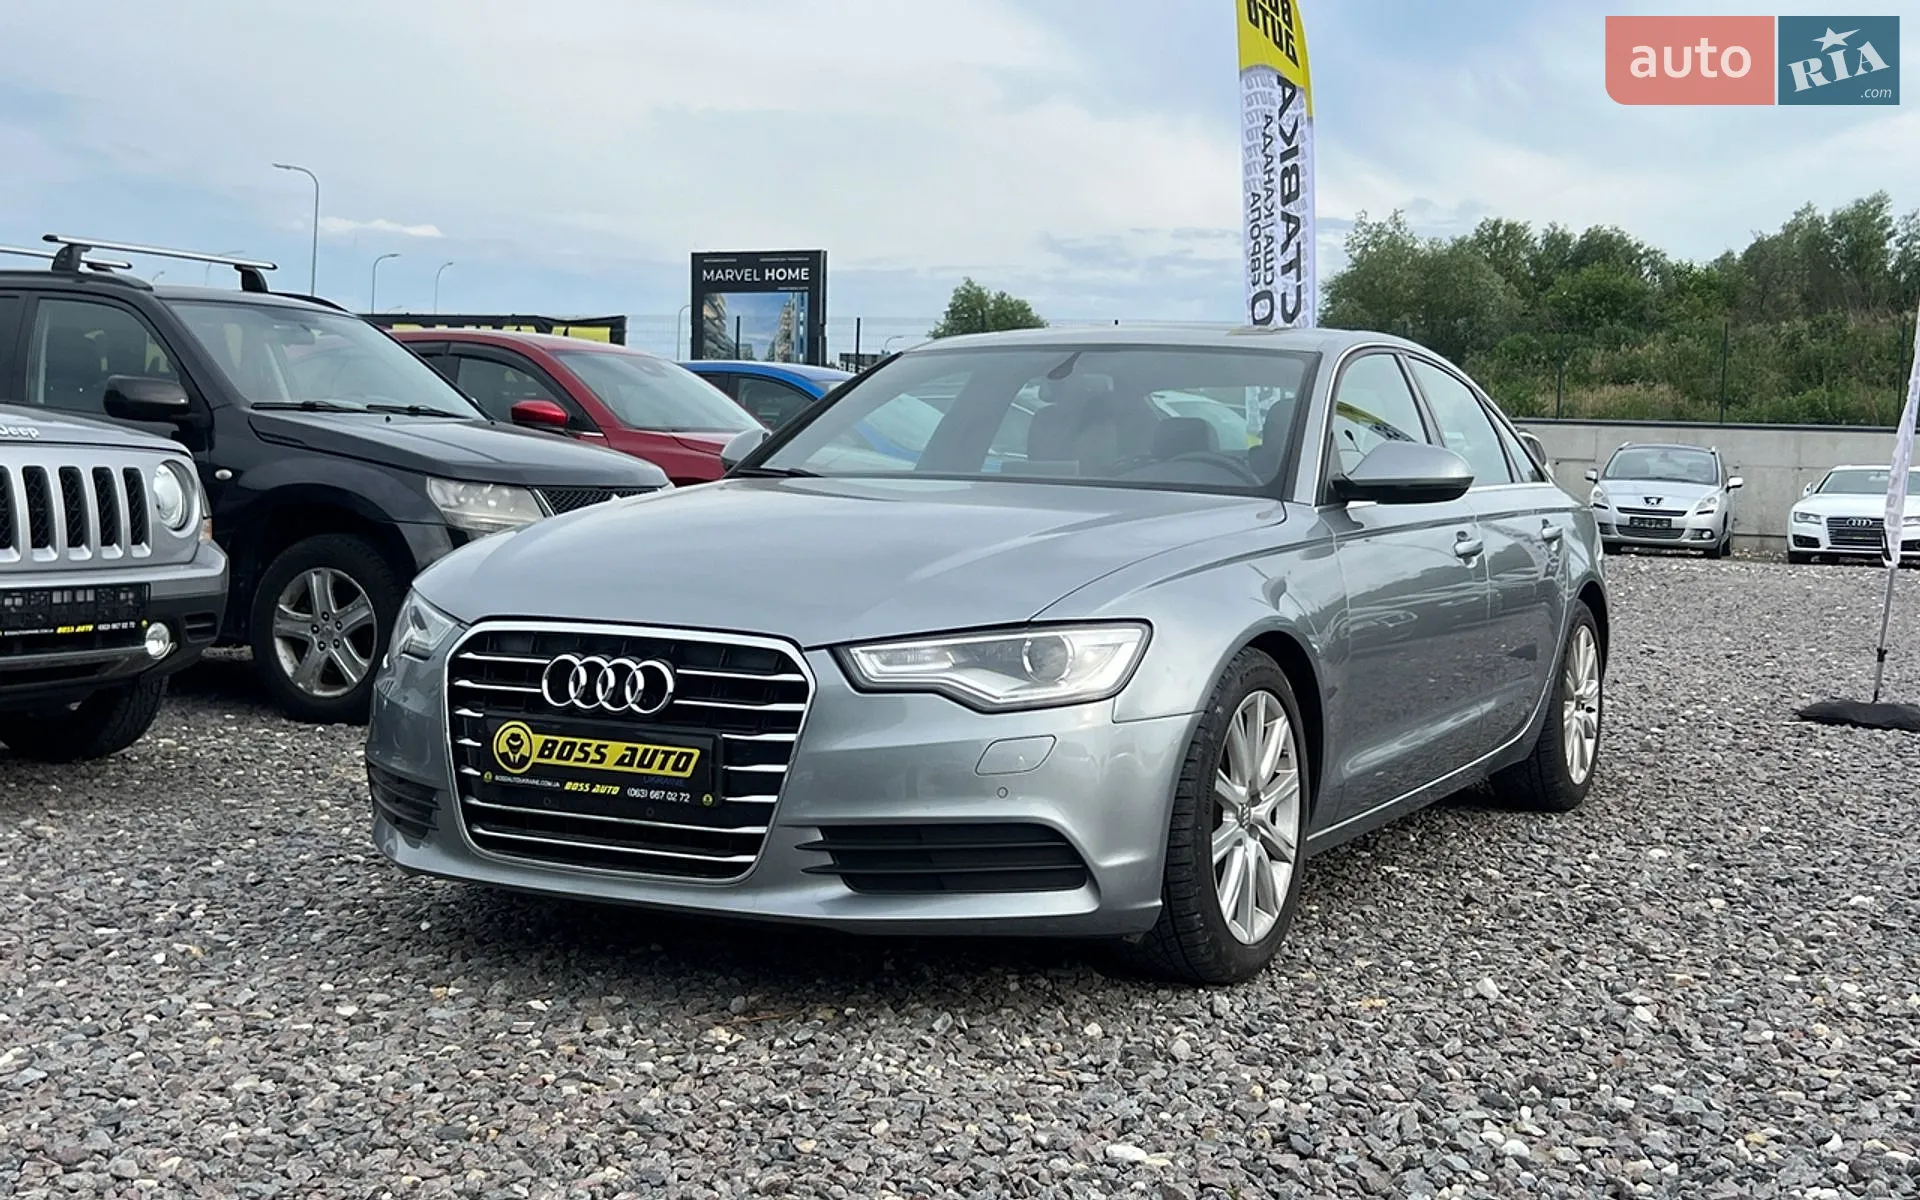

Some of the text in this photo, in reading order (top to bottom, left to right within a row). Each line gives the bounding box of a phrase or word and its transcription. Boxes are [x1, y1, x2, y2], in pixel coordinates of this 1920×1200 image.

[702, 267, 810, 282] MARVEL HOME
[536, 739, 695, 773] BOSS AUTO
[564, 781, 620, 796] BOSS AUTO
[626, 787, 648, 798] (063)
[666, 791, 678, 802] 02
[679, 792, 691, 803] 72
